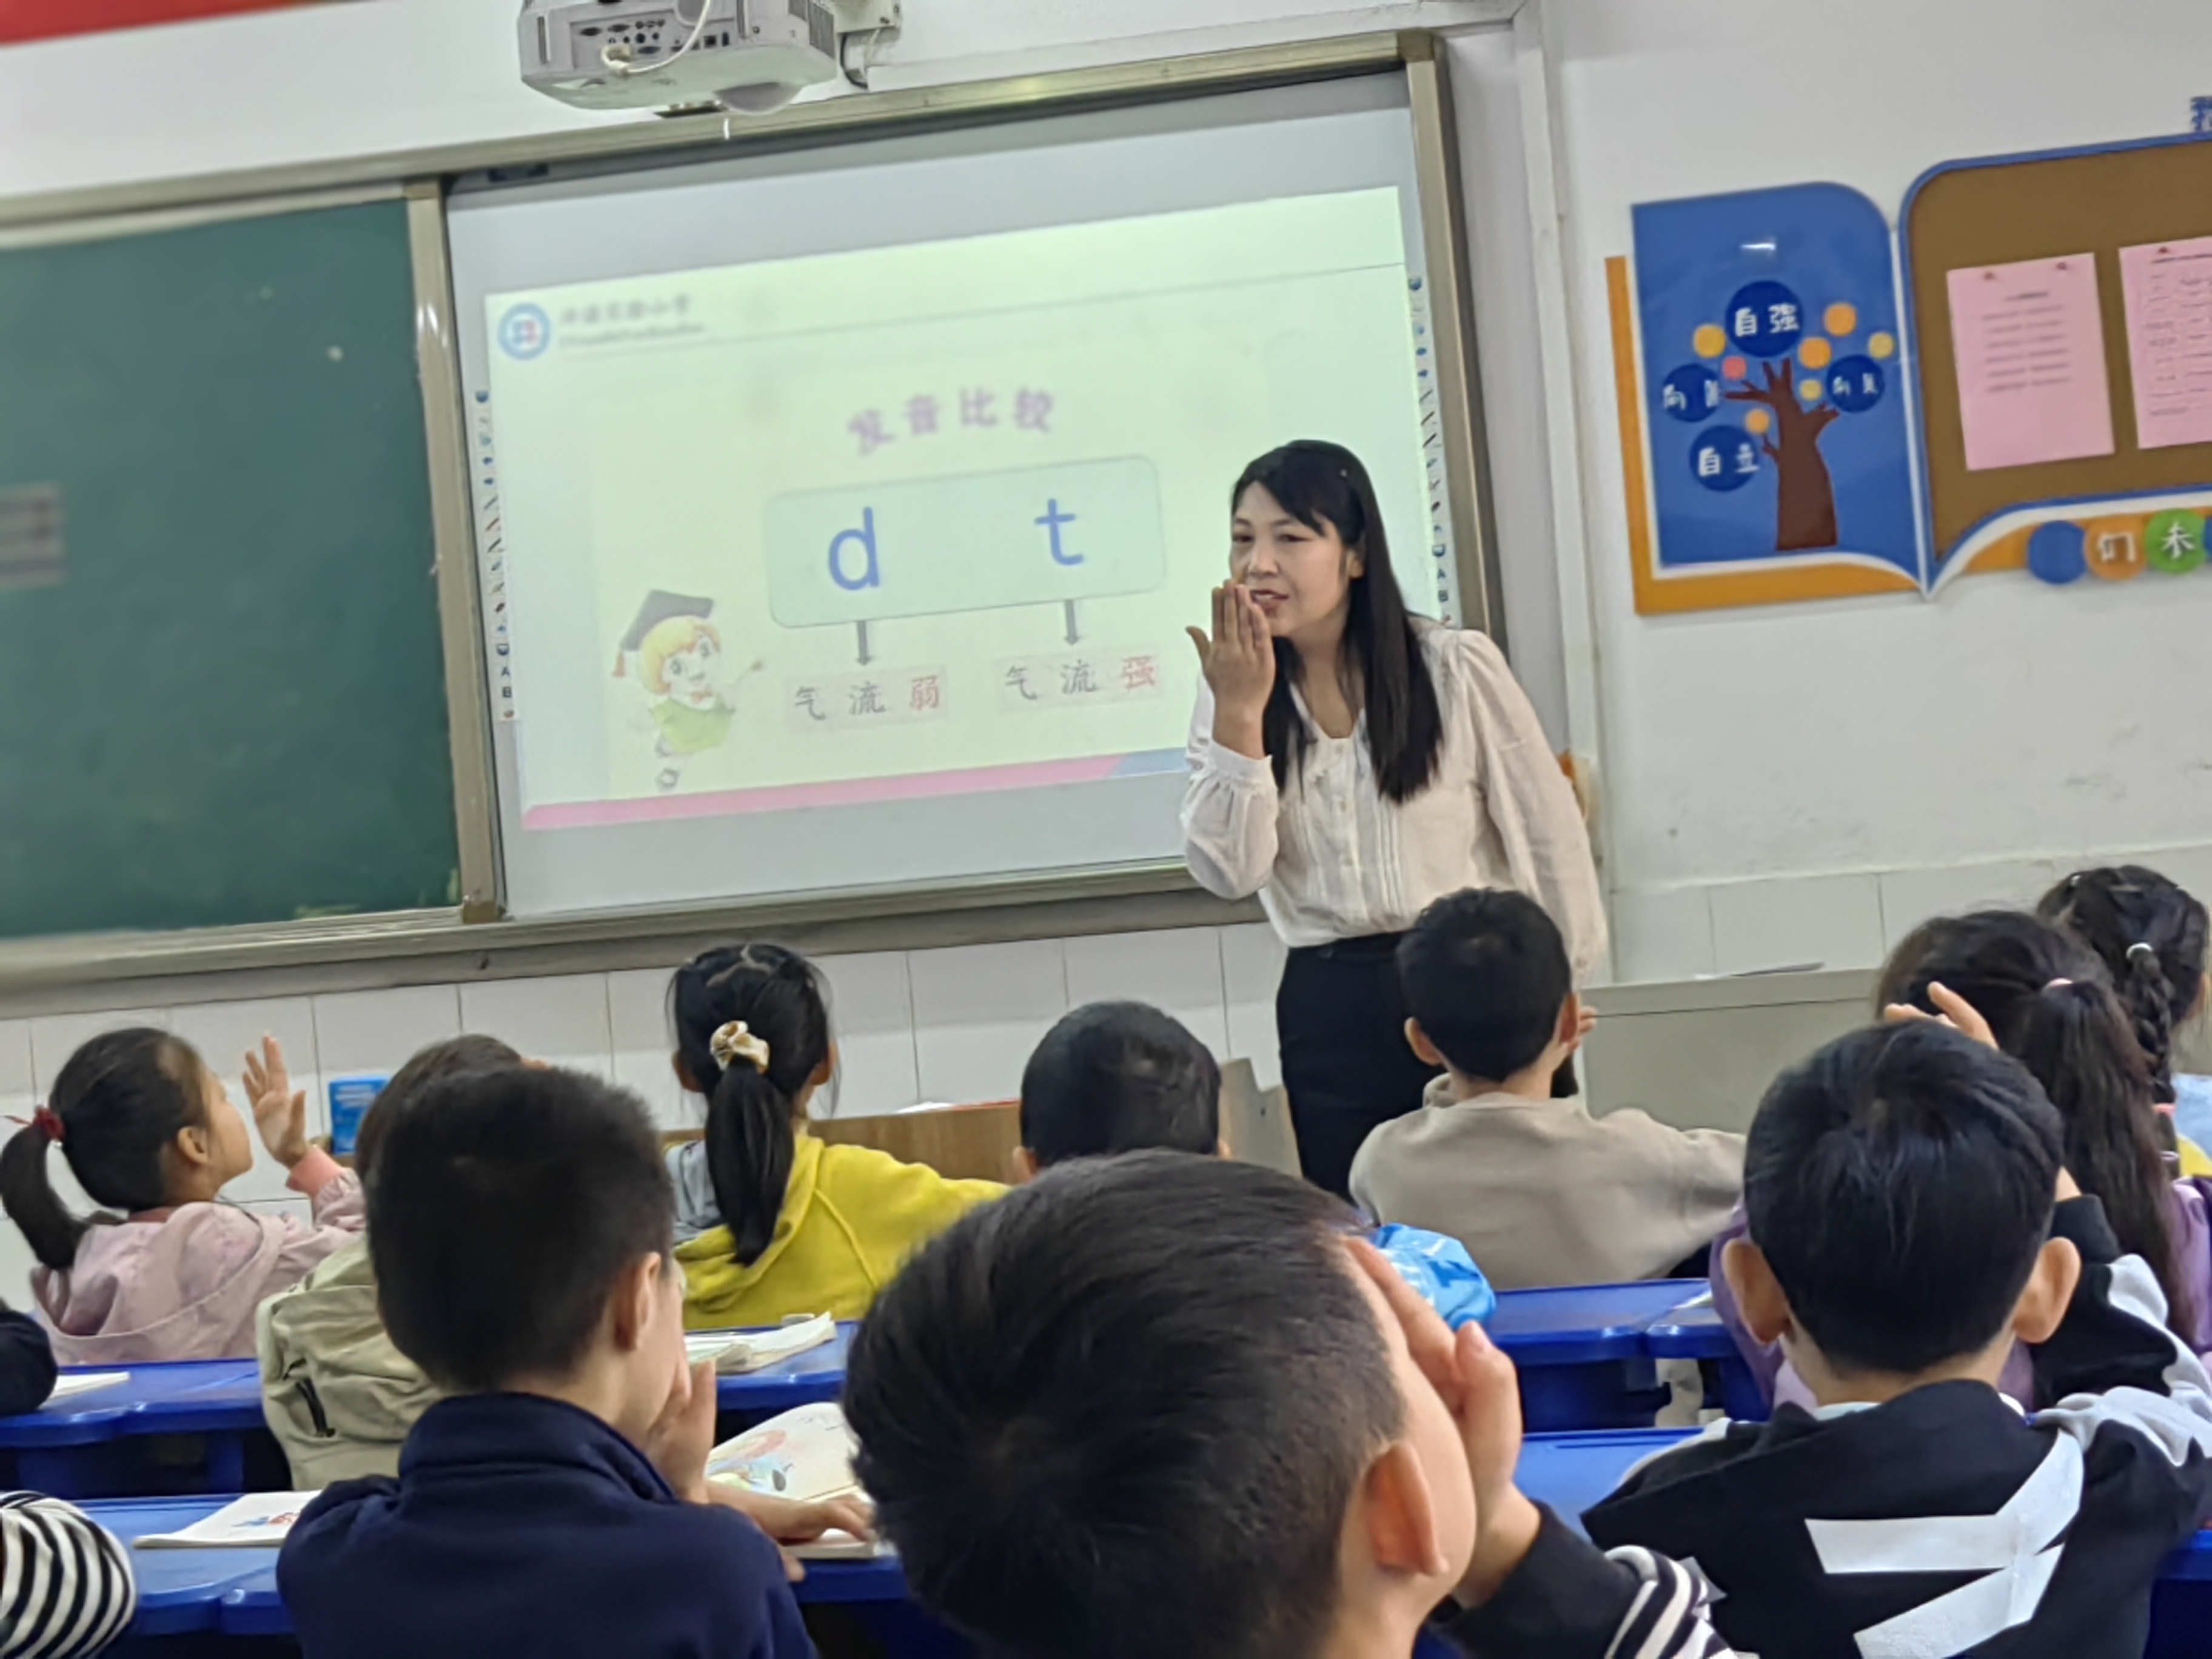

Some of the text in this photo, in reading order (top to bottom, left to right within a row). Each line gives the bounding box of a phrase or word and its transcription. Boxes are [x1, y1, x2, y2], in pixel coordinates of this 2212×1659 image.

[1735, 303, 1798, 337] 自强
[1698, 443, 1758, 477] 自立
[827, 498, 1085, 591] d t
[794, 674, 941, 722] 气流弱
[1004, 655, 1156, 702] 气流强
